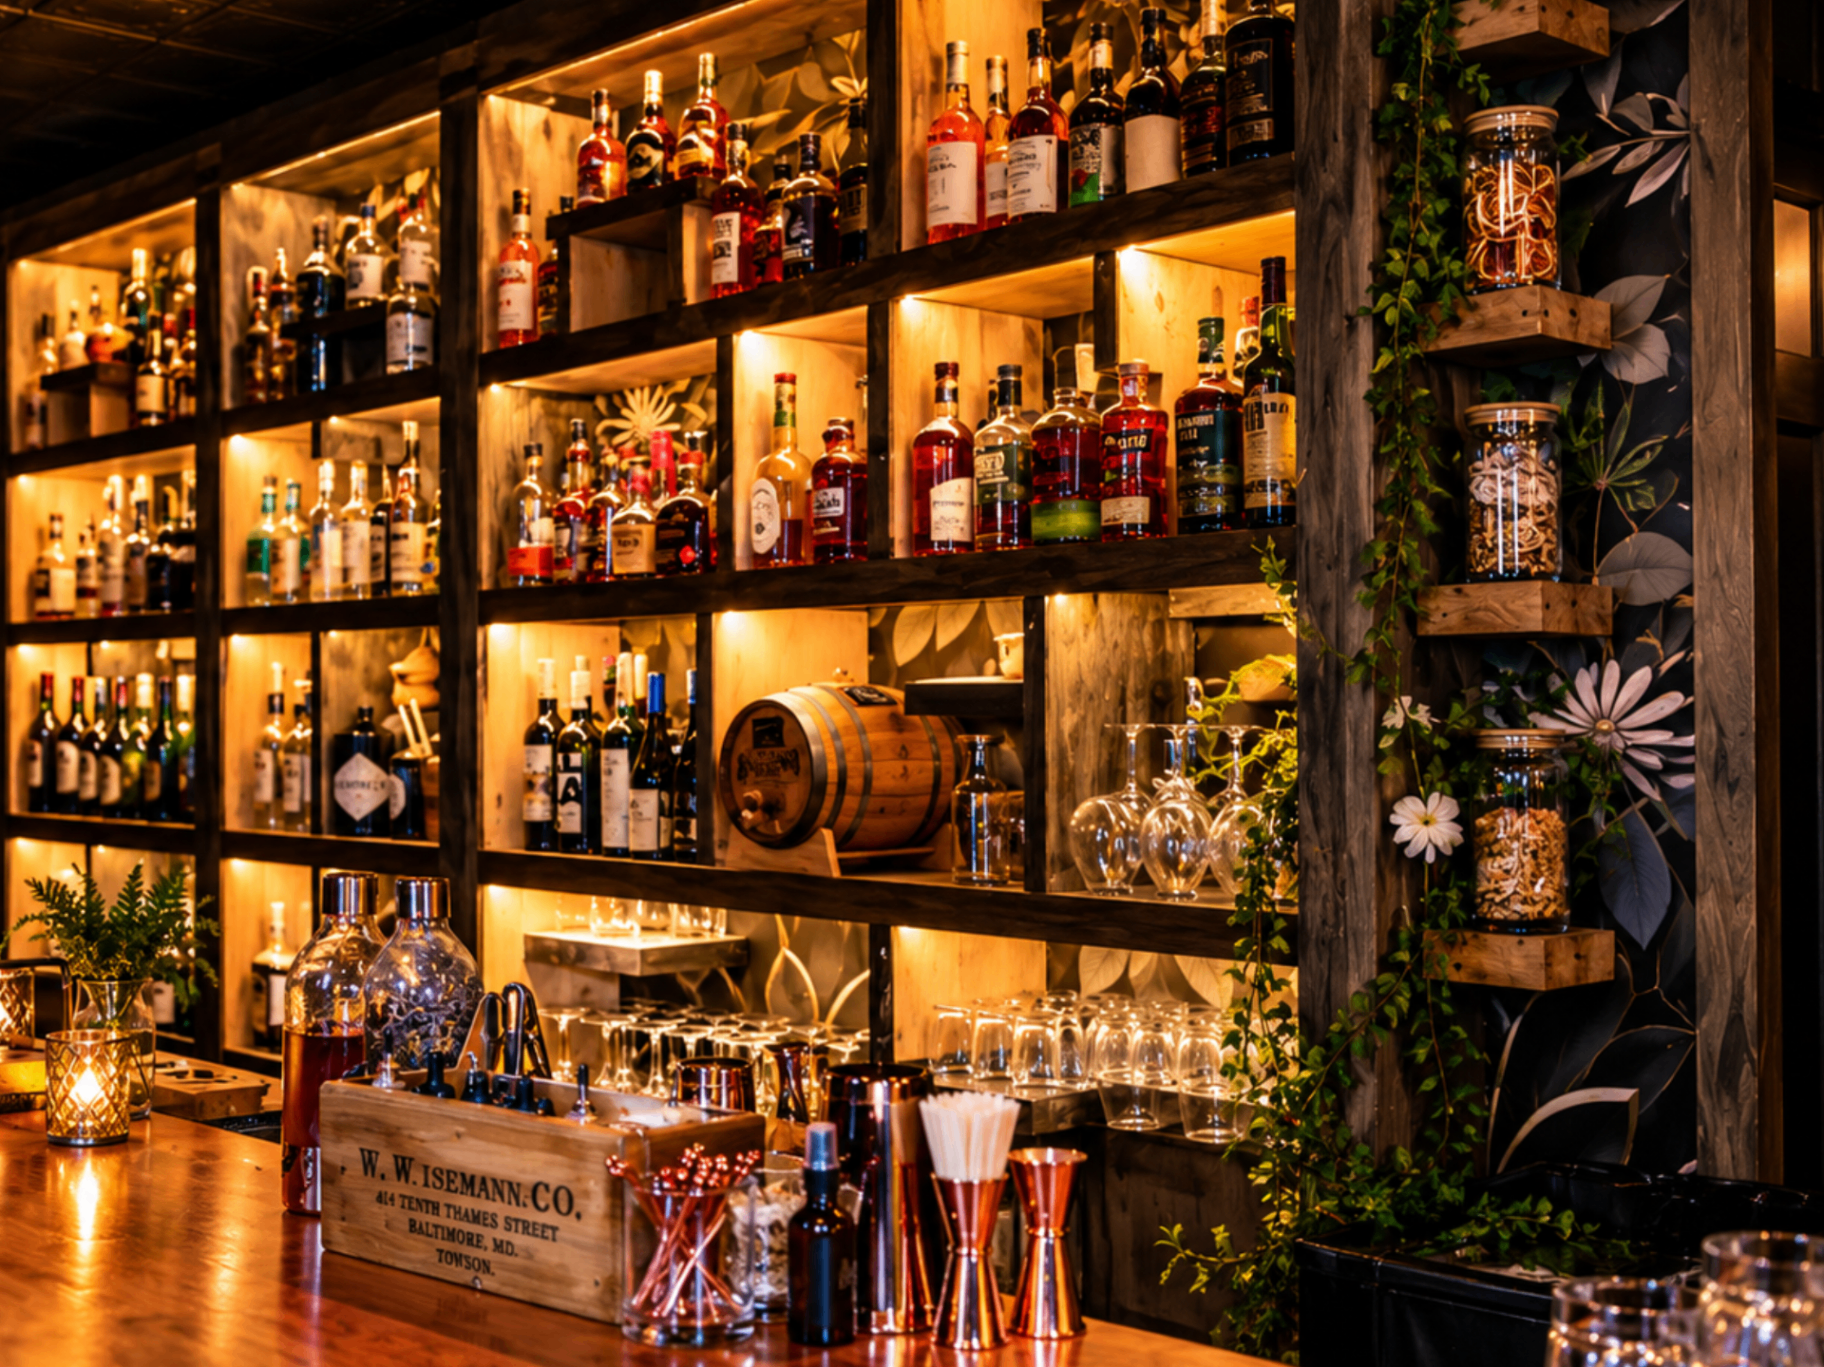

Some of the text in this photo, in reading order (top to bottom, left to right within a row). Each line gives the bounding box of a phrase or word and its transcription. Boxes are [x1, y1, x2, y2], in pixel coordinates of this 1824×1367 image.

[359, 1147, 386, 1181] W.
[393, 1154, 418, 1186] W.
[531, 1181, 582, 1221] CO.
[399, 1194, 441, 1217] TENTH
[444, 1203, 499, 1229] THAMES
[504, 1216, 559, 1242] STREET
[408, 1218, 518, 1257] BALTIMORE, MD.
